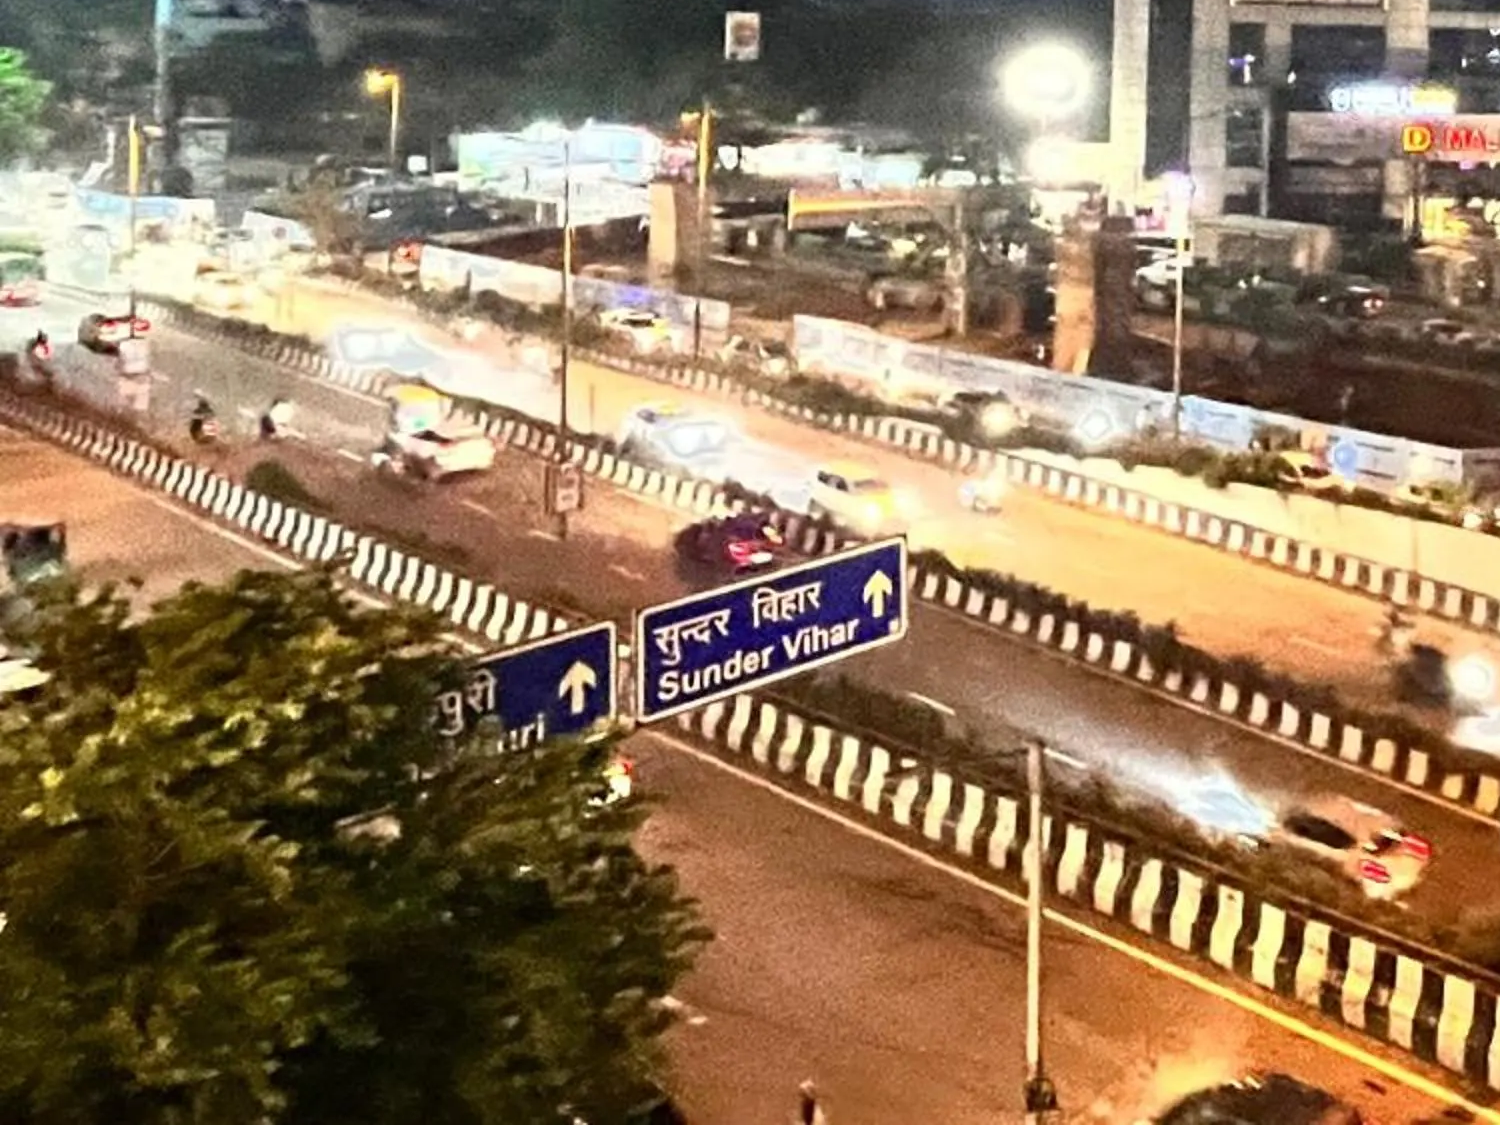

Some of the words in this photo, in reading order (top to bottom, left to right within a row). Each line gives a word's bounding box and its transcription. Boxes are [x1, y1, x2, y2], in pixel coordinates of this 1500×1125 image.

[653, 609, 731, 665] सुन्दर
[752, 581, 823, 628] विहार
[657, 646, 775, 701] Sunder
[782, 618, 861, 661] Vihar
